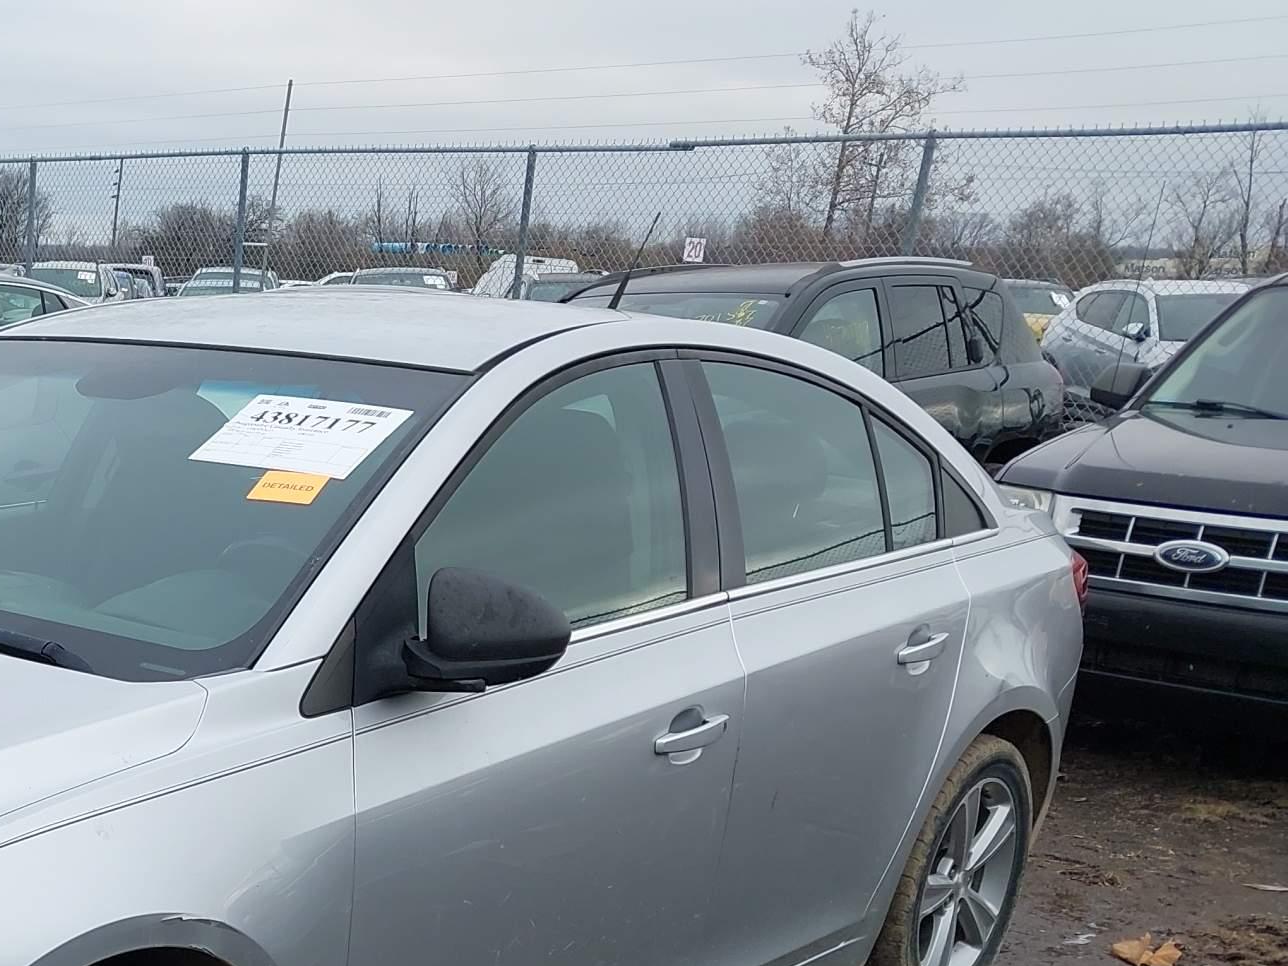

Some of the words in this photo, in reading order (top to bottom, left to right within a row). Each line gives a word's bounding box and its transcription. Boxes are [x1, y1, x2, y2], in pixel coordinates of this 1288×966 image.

[687, 241, 703, 258] 20
[250, 410, 377, 434] 43817177
[262, 481, 315, 492] DETAILED
[1172, 548, 1207, 563] Ford
